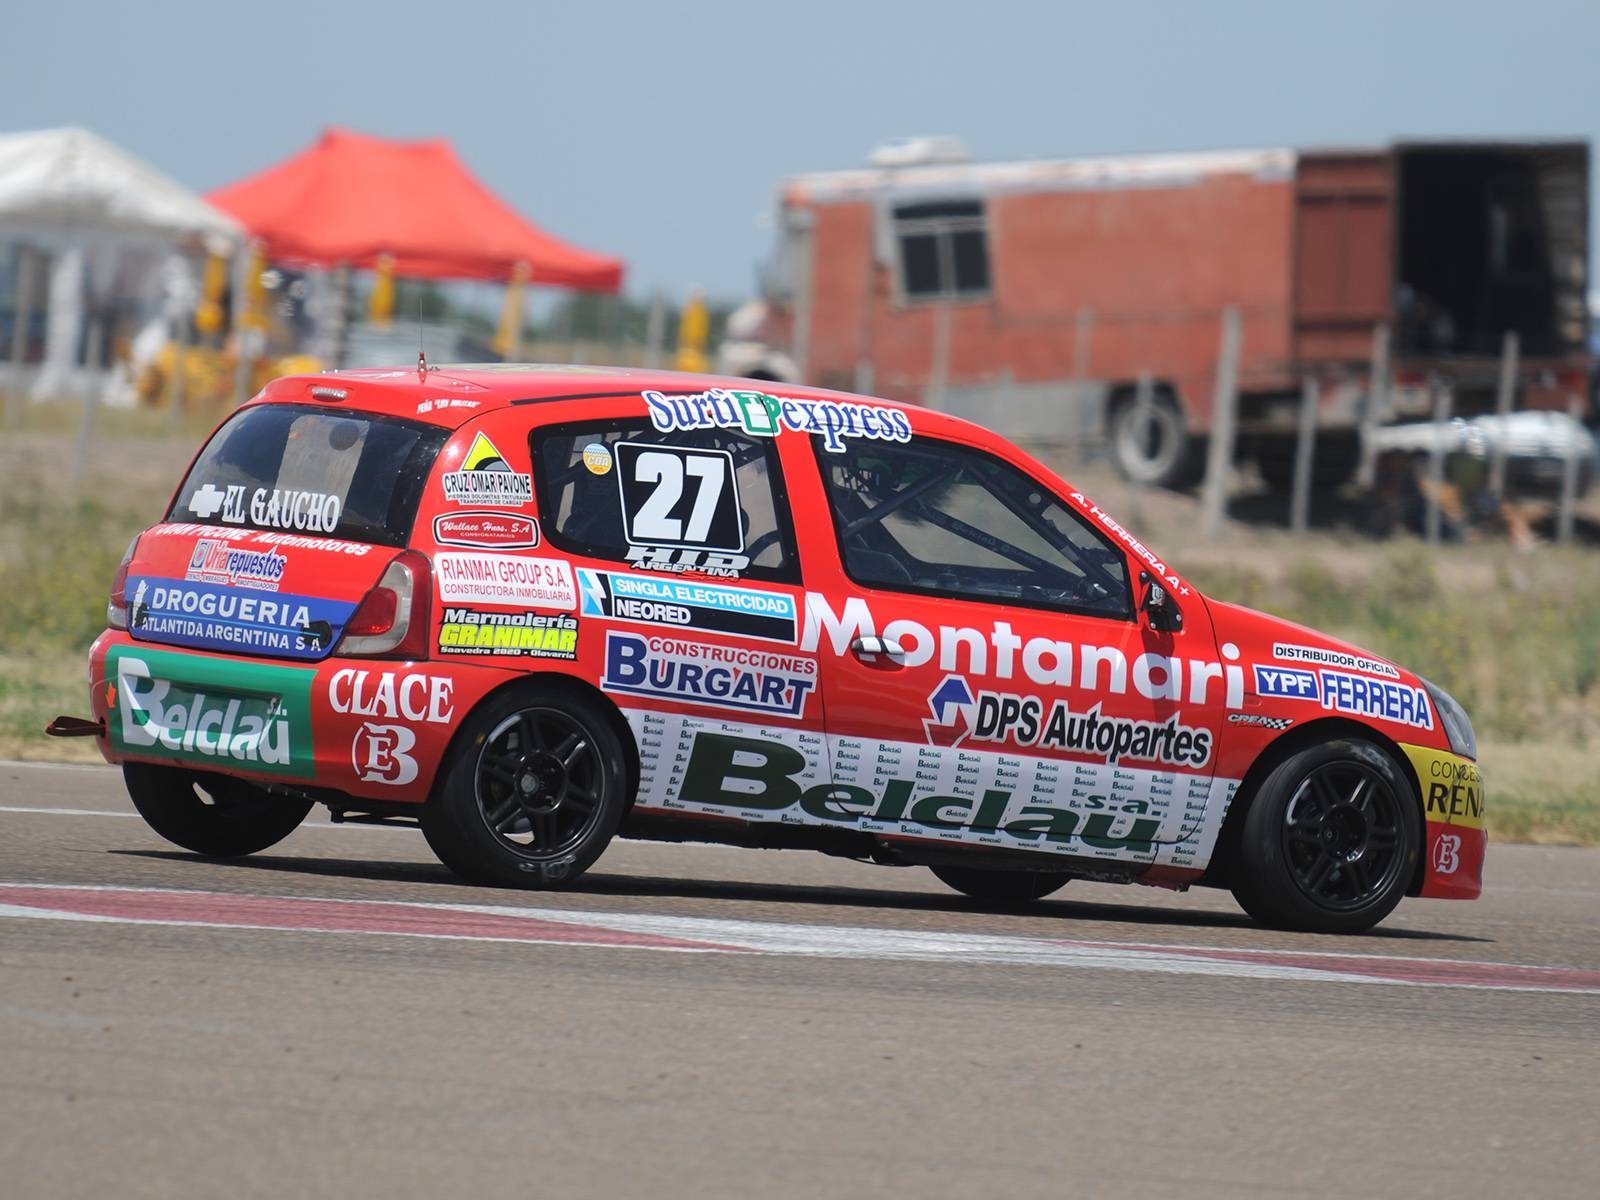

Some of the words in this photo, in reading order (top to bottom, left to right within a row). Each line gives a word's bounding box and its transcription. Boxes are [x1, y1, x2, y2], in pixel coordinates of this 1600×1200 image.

[645, 389, 742, 429] Surti
[781, 399, 910, 450] express
[444, 473, 469, 493] CRUZ
[471, 473, 495, 493] OMAR
[498, 474, 531, 494] PAVONE
[632, 451, 725, 543] 27
[221, 485, 246, 524] EL
[251, 488, 341, 533] GAUCHO
[441, 521, 479, 532] Wallace
[1089, 506, 1166, 576] HERRERA
[251, 532, 373, 556] Automotores
[442, 559, 498, 582] RIANMAI
[499, 561, 542, 585] GROUP
[544, 565, 571, 588] S.A.
[631, 560, 740, 579] ARGENTINA
[152, 587, 311, 629] DROGUERIA
[444, 583, 514, 597] CONSTRUCTORA
[516, 587, 572, 602] INMOBILIARIA
[616, 579, 673, 599] SINGLA
[676, 586, 789, 614] ELECTRICIDAD
[444, 608, 578, 630] Marmolería
[616, 599, 692, 625] NEORED
[141, 616, 206, 637] ATLANTIDA
[206, 623, 290, 650] ARGENTINA
[439, 623, 578, 653] GRANIMAR
[801, 591, 1244, 709] Montanari
[440, 646, 491, 655] Saavedra
[649, 638, 816, 675] CONSTRUCCIONES
[1274, 646, 1355, 667] DISTRIBUIDOR
[1358, 659, 1398, 676] OFICIAL
[606, 635, 814, 715] BURGART
[328, 668, 455, 724] CLACE
[1260, 671, 1314, 695] YPF
[1321, 672, 1431, 727] FERRERA
[974, 695, 1041, 742] DPS
[1042, 704, 1211, 764] Autopartes
